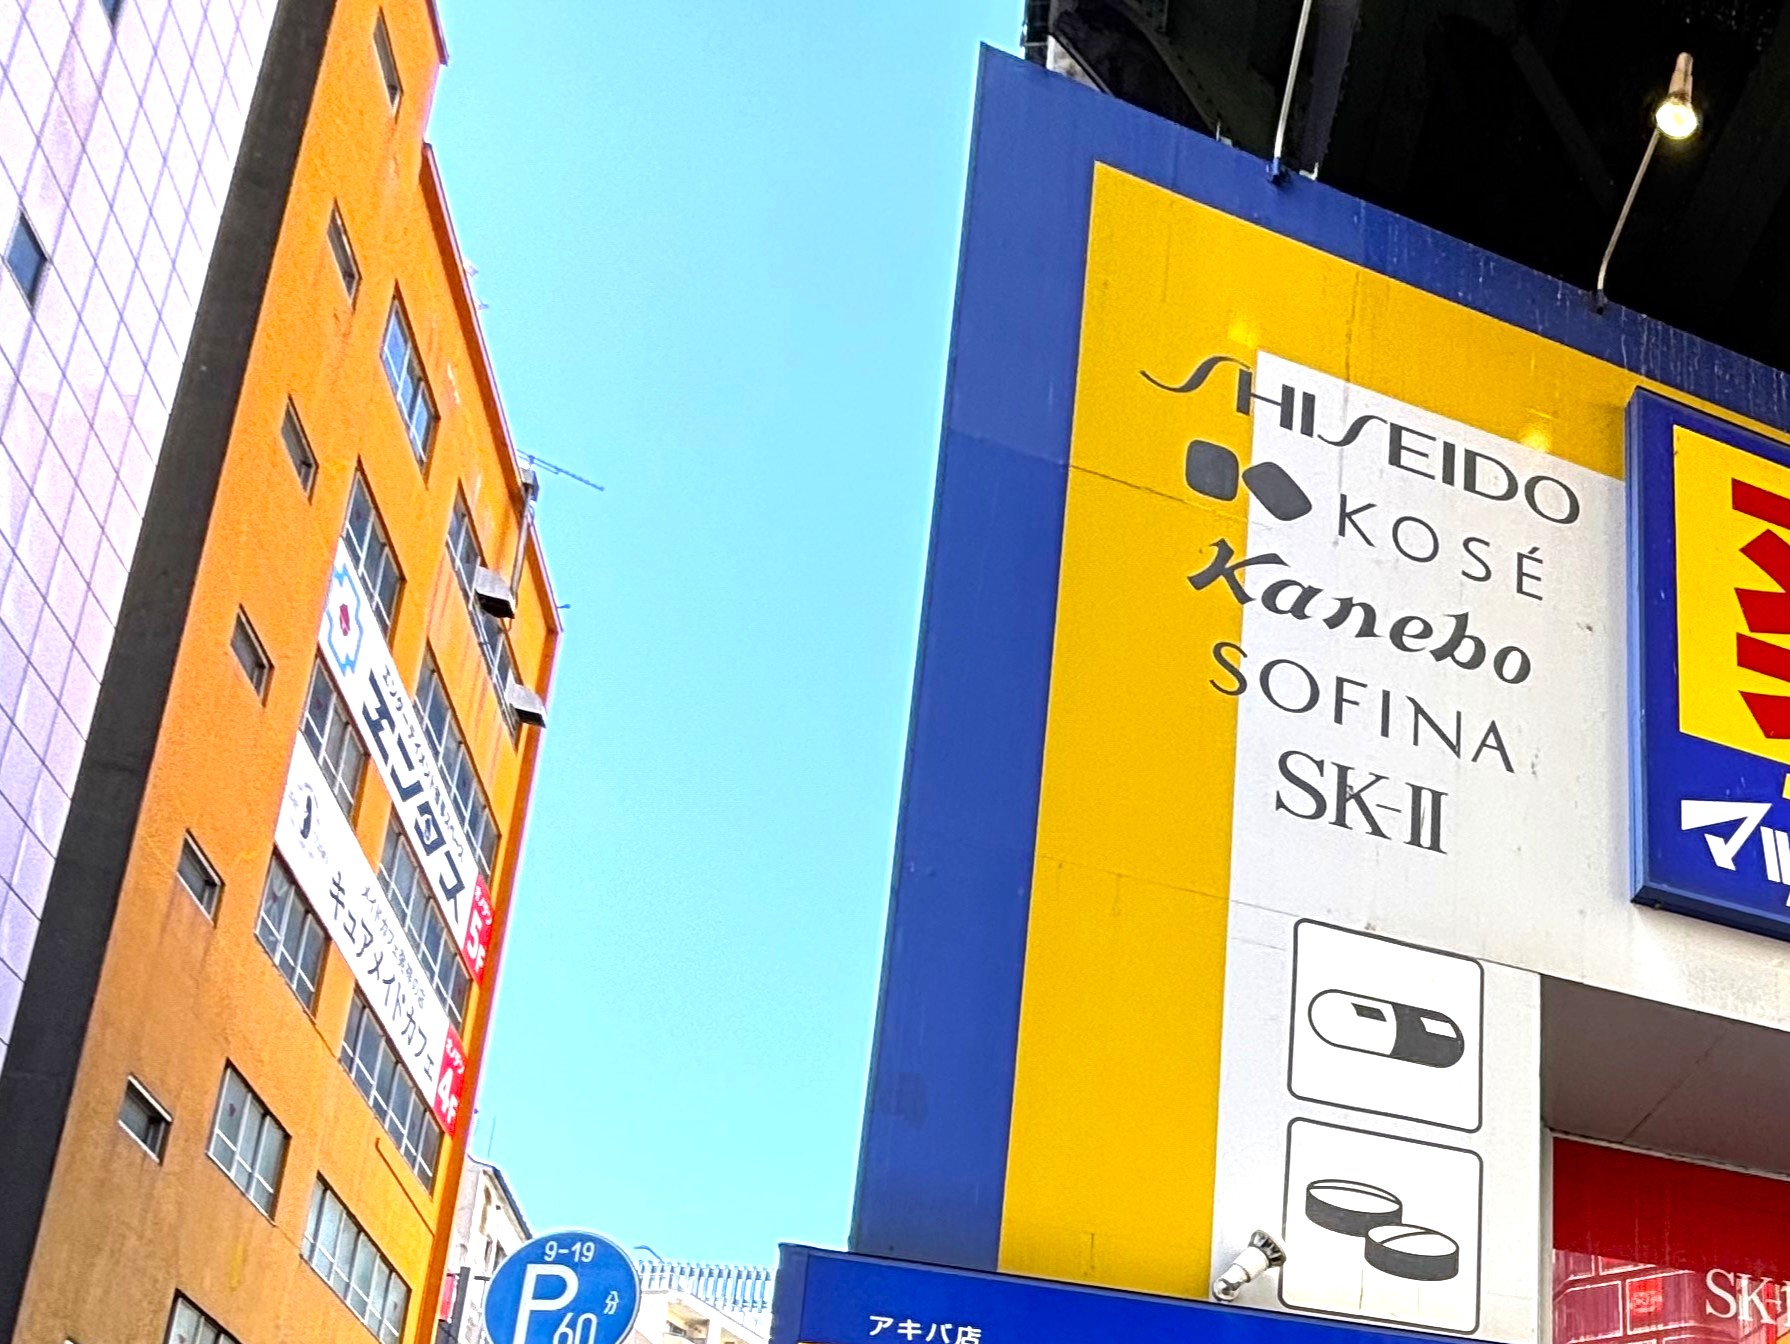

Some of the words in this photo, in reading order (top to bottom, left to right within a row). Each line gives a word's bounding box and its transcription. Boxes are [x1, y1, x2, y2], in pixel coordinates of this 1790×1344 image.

[1140, 355, 1581, 525] SHISEIDO
[1338, 493, 1544, 601] KOSÉ
[1187, 538, 1533, 686] Kanebo
[1209, 641, 1516, 774] SOFINA
[1275, 750, 1449, 855] SK-II
[466, 908, 487, 972] 5F
[543, 1240, 595, 1263] 9-19
